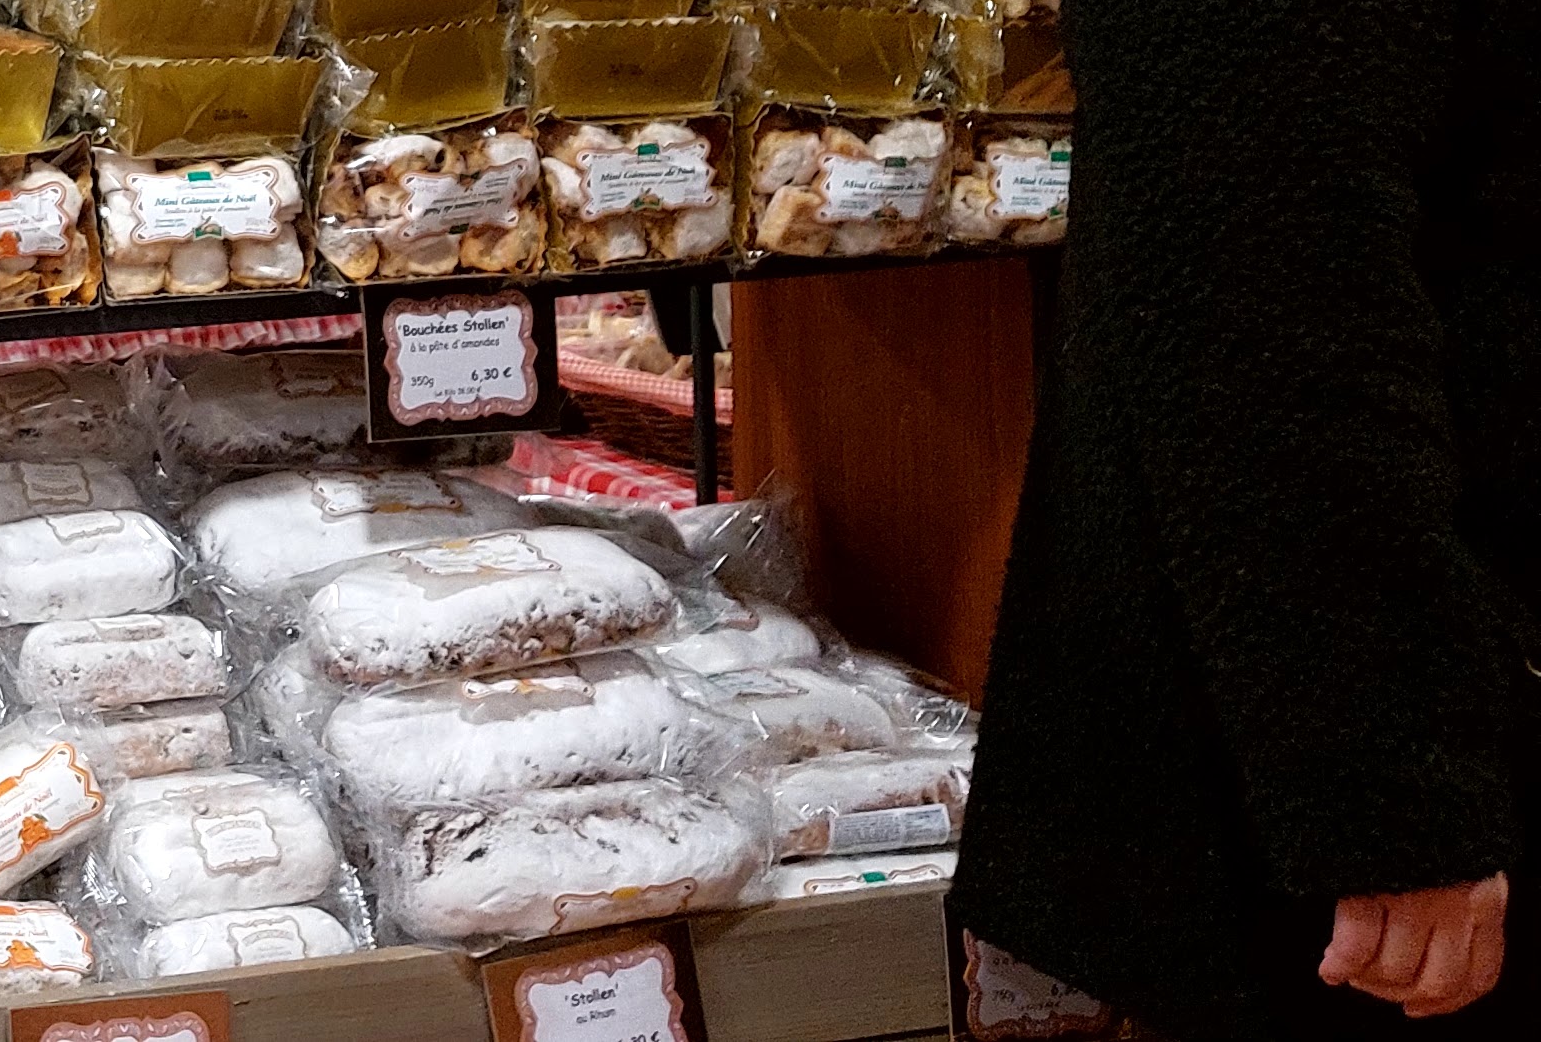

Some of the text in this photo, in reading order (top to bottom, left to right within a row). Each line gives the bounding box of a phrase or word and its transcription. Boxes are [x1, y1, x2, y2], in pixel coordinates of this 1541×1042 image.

[155, 197, 178, 206] Mini
[223, 194, 233, 203] de
[235, 194, 257, 203] Noël
[411, 366, 512, 388] 350g 6,30 €
